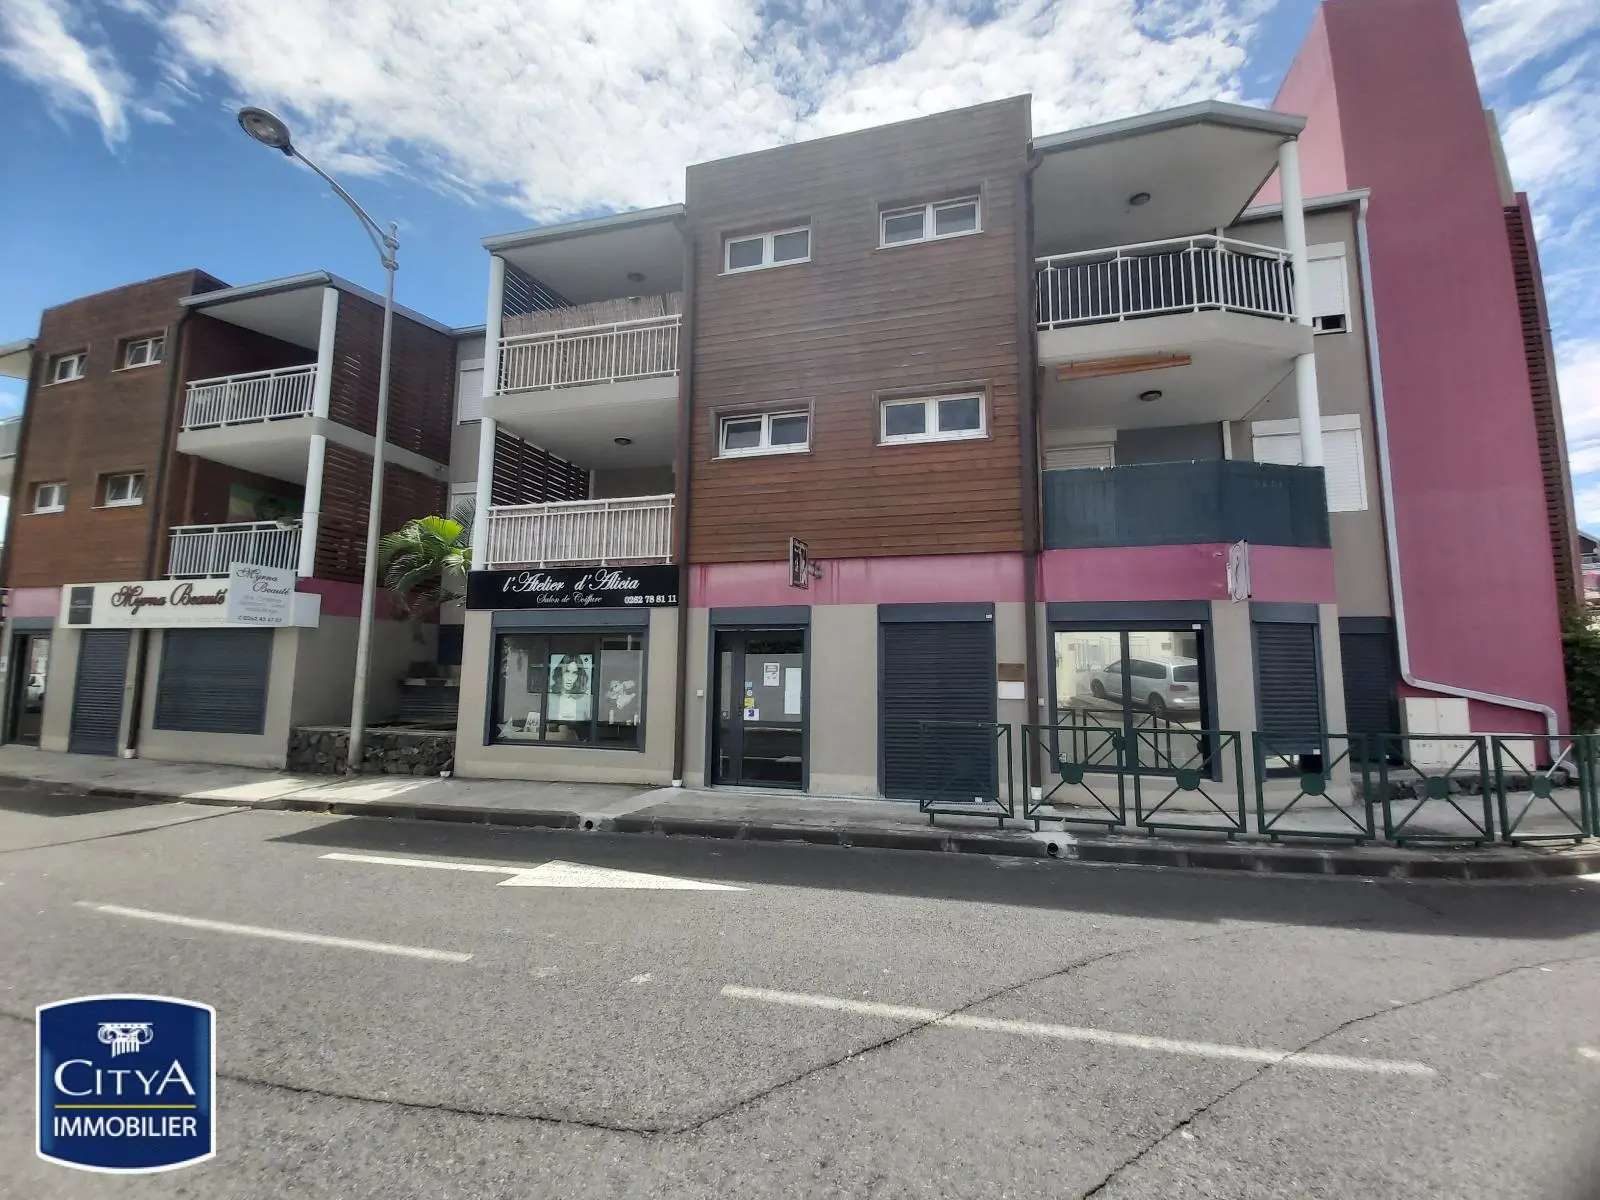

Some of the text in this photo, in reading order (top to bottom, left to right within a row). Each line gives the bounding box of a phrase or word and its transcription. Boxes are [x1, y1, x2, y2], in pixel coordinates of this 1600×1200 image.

[236, 568, 277, 583] Myrna
[502, 568, 640, 592] l'Atelier d'Alicia
[252, 582, 291, 595] Beauté
[111, 585, 166, 615] Myrna
[170, 583, 228, 605] Beauté
[536, 592, 603, 605] Salon de Coiffure
[624, 595, 643, 604] 0262
[645, 594, 655, 604] 78
[667, 594, 677, 603] 11
